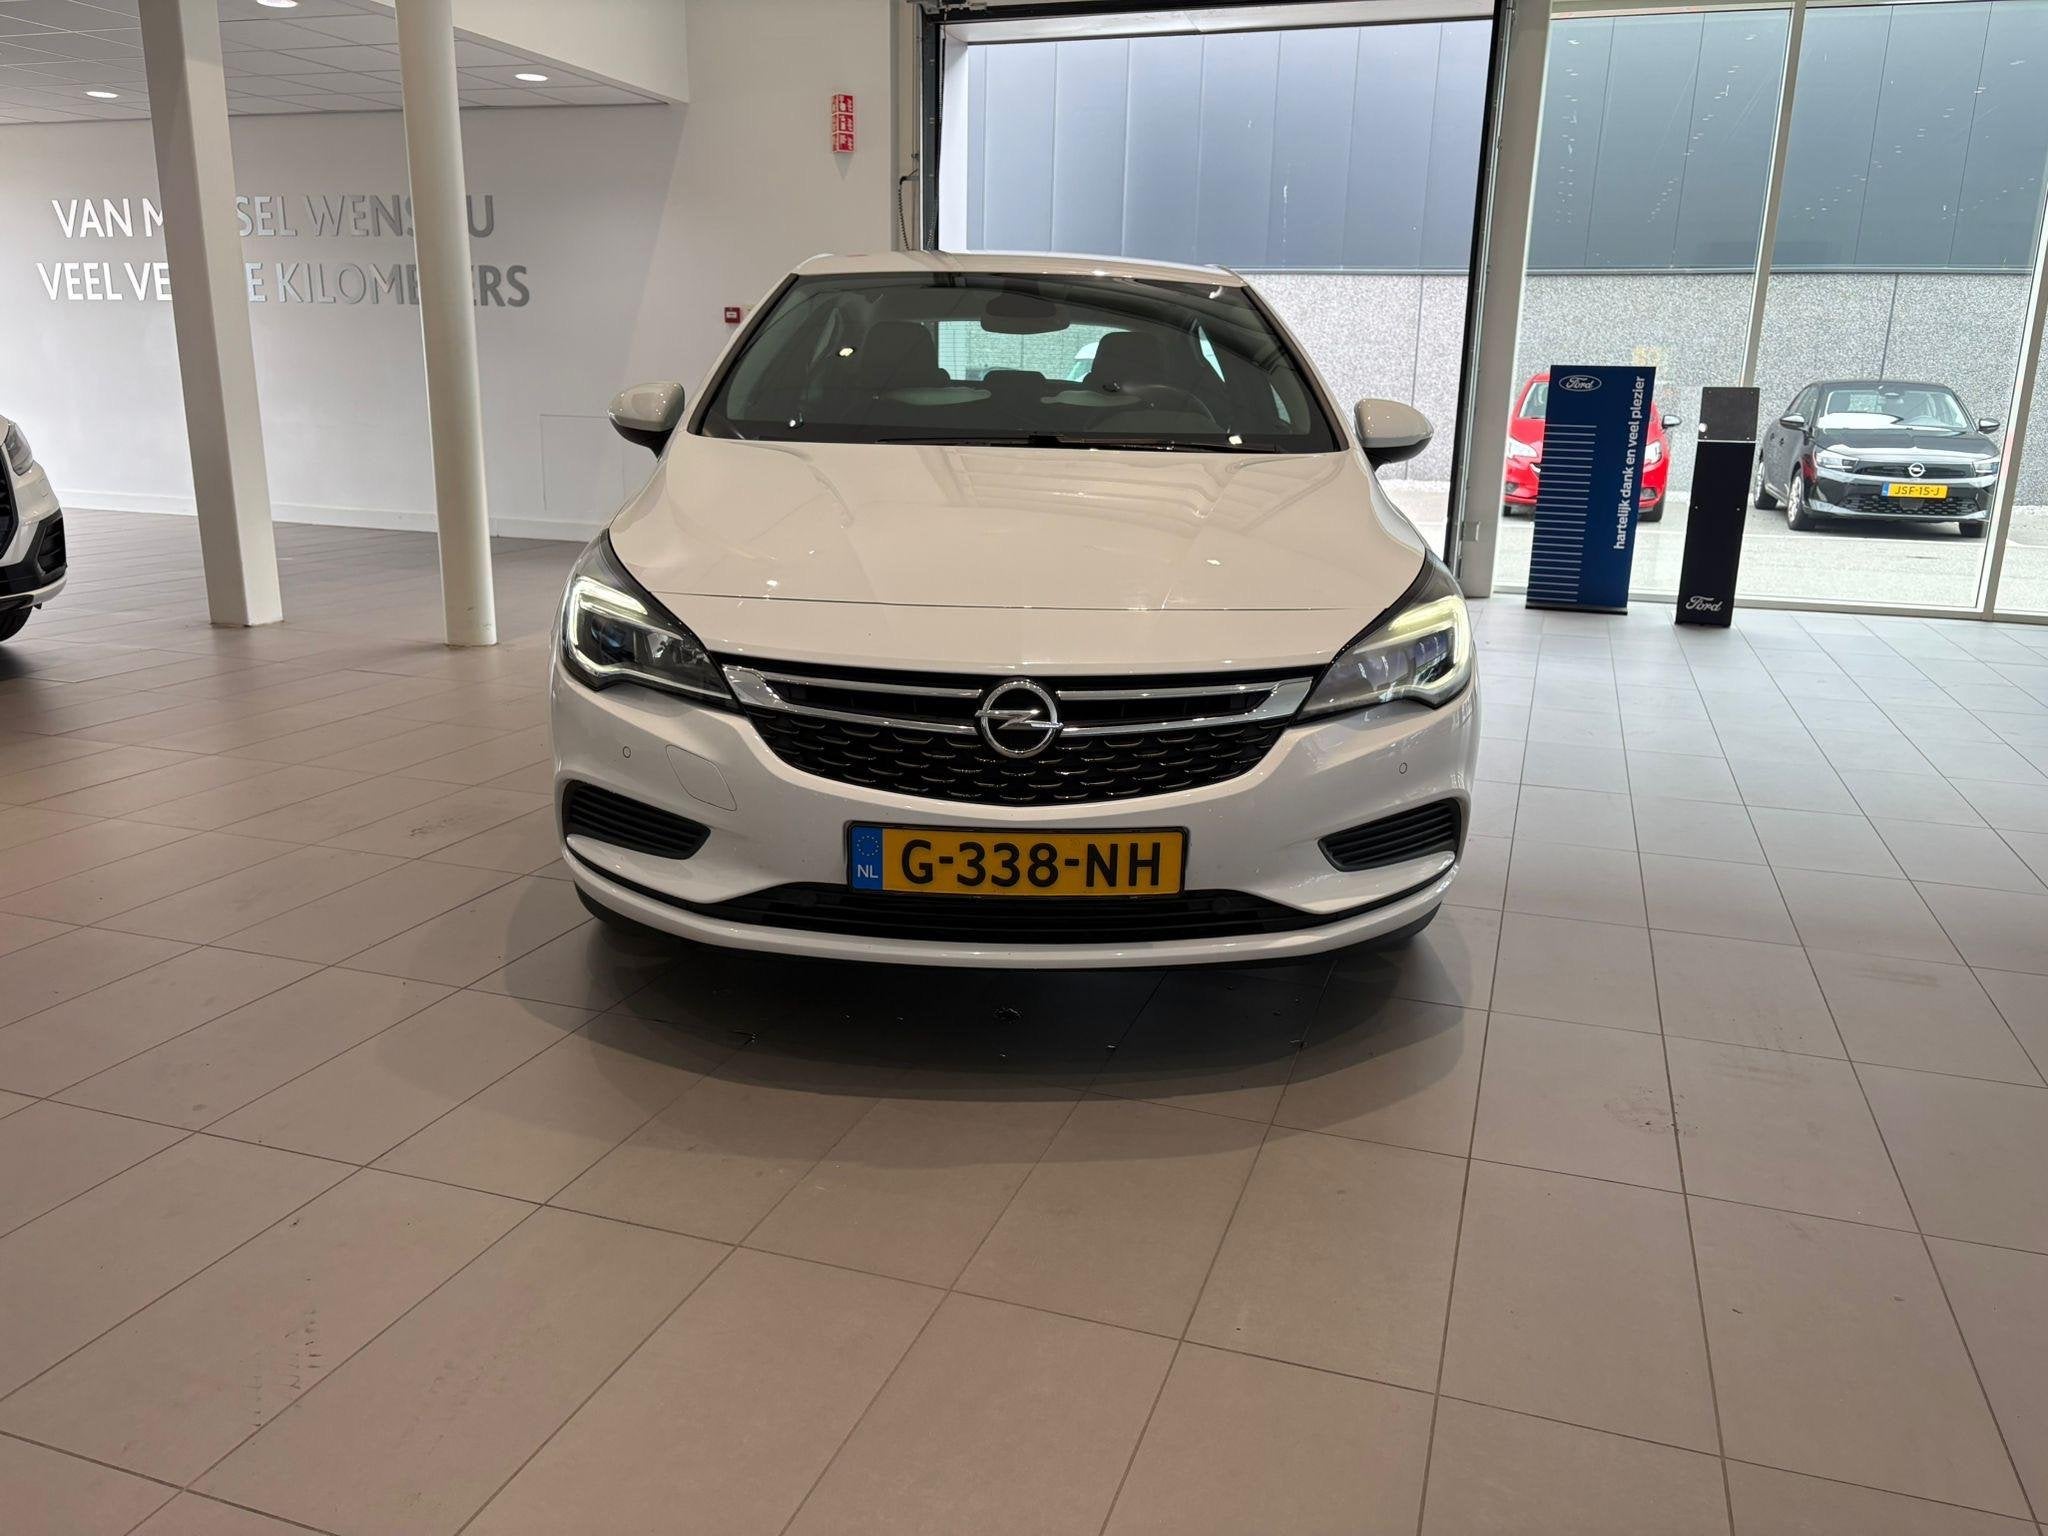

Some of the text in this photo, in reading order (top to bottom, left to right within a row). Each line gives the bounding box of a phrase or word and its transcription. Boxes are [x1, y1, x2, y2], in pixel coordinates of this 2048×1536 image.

[51, 198, 133, 238] VAN
[142, 195, 298, 237] MSEL
[465, 194, 495, 238] U
[36, 262, 123, 301] VEEL
[275, 262, 530, 308] KILOMERS
[1564, 376, 1596, 389] Ford
[1613, 376, 1646, 549] hartelijk dank en veel plezier
[1894, 485, 1940, 496] JSF-15-J
[1685, 595, 1723, 611] Ford
[857, 864, 879, 879] NL
[901, 838, 1161, 888] G-338-NH
